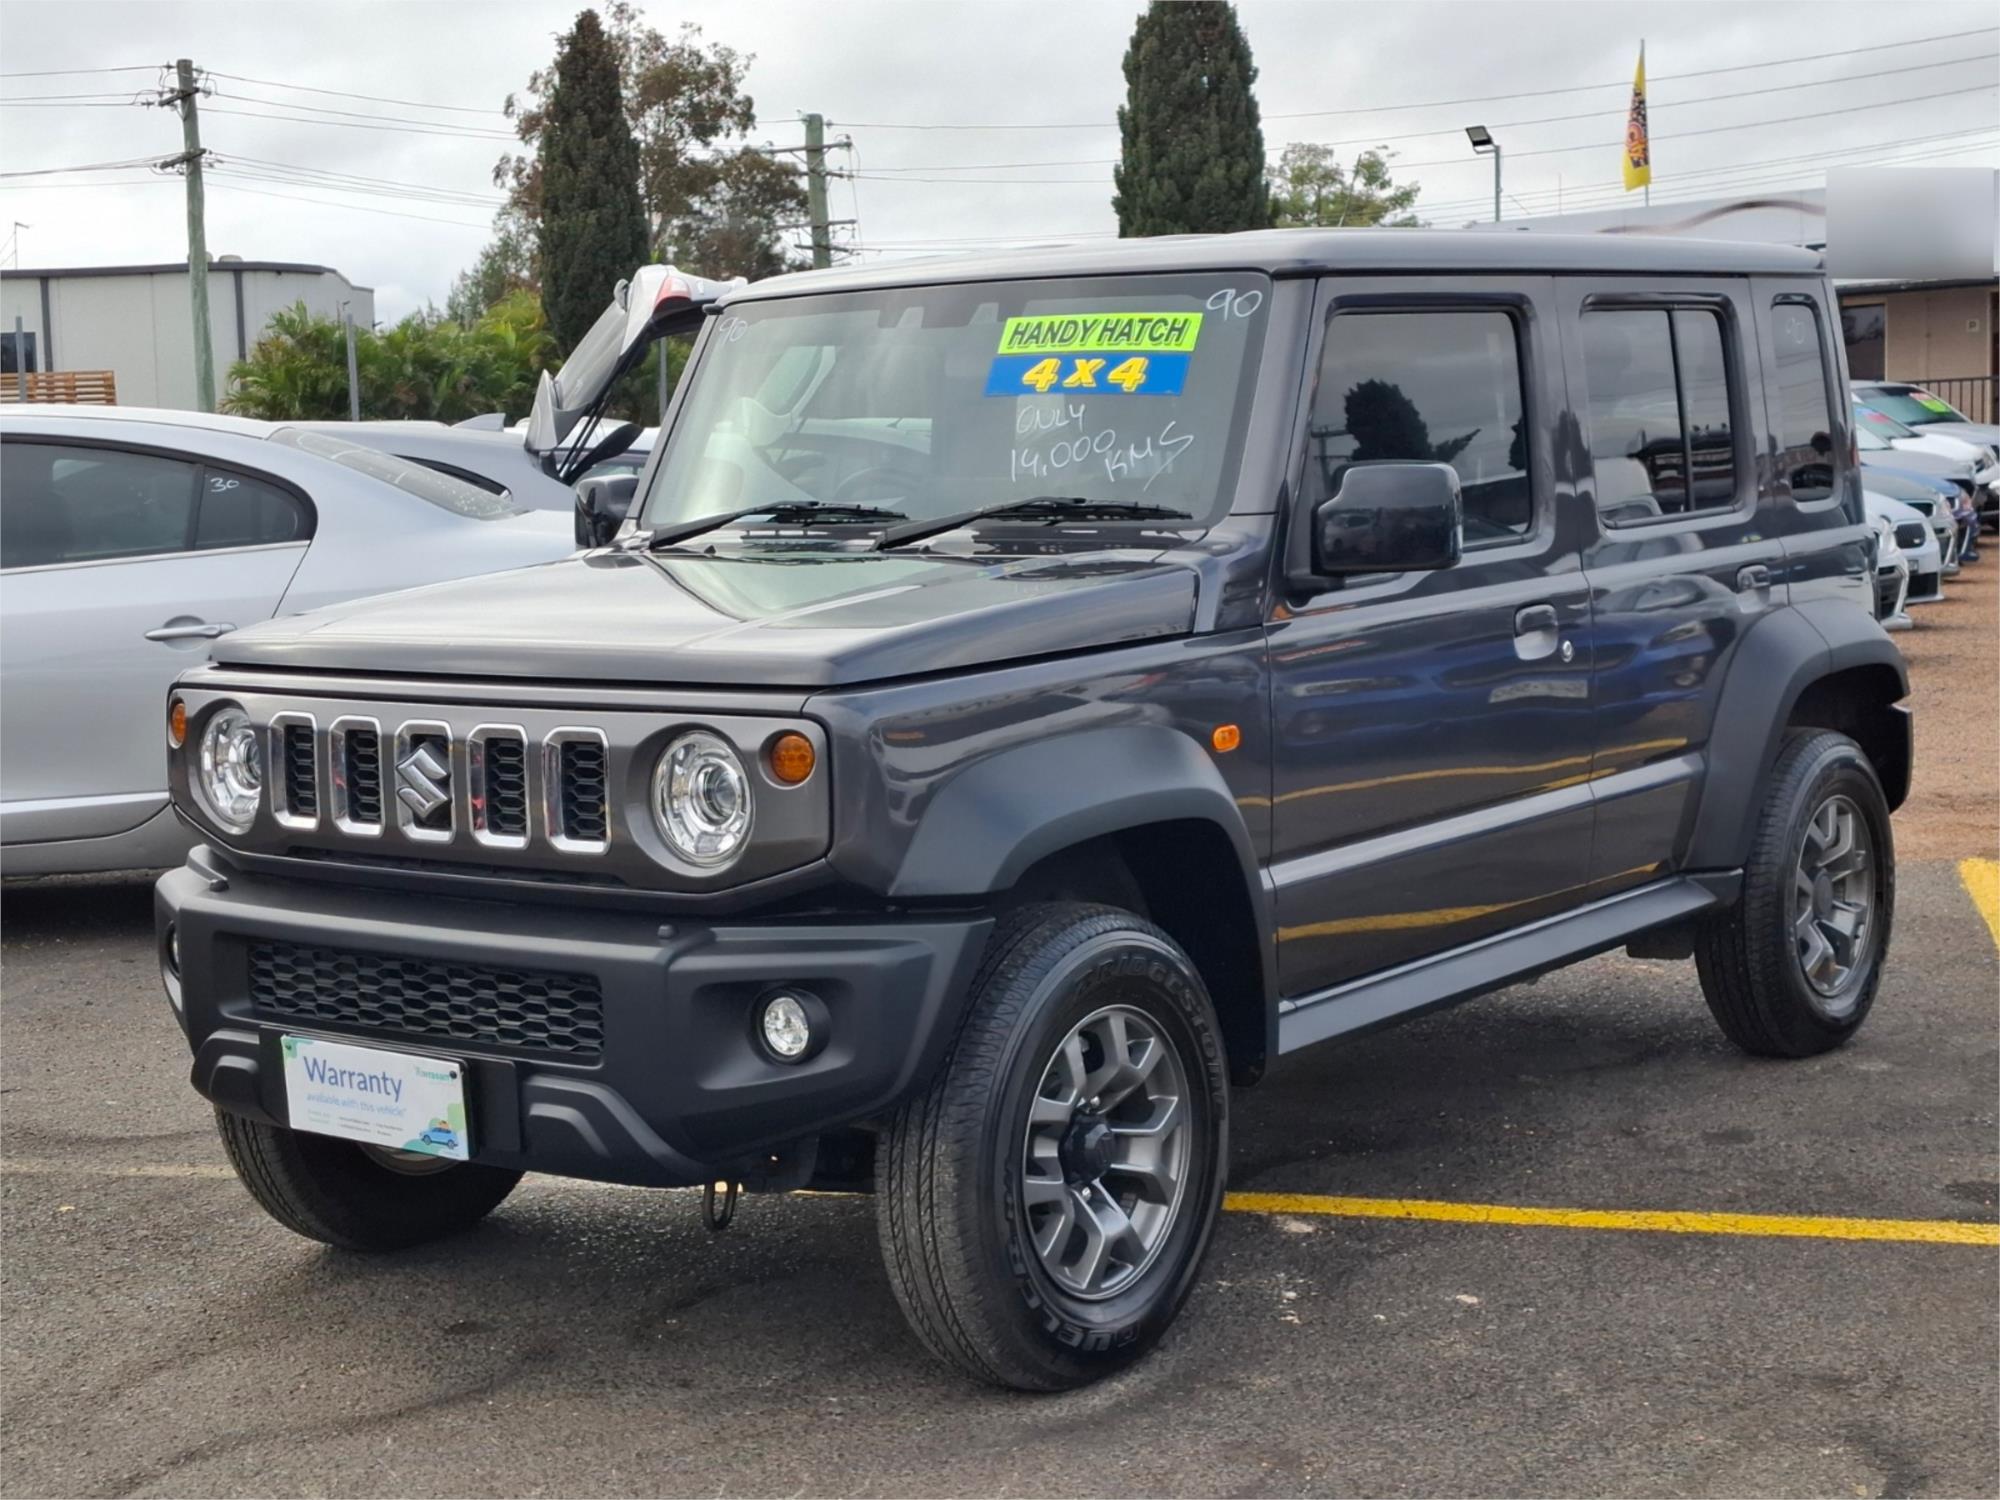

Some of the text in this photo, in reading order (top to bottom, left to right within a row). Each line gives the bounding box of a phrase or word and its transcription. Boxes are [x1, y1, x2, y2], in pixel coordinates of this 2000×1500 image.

[1206, 288, 1263, 320] 90
[720, 316, 748, 348] 90
[1008, 317, 1192, 347] HANDY HATCH
[1016, 403, 1086, 434] ONLY
[210, 477, 240, 492] 30
[303, 1055, 402, 1103] Warranty
